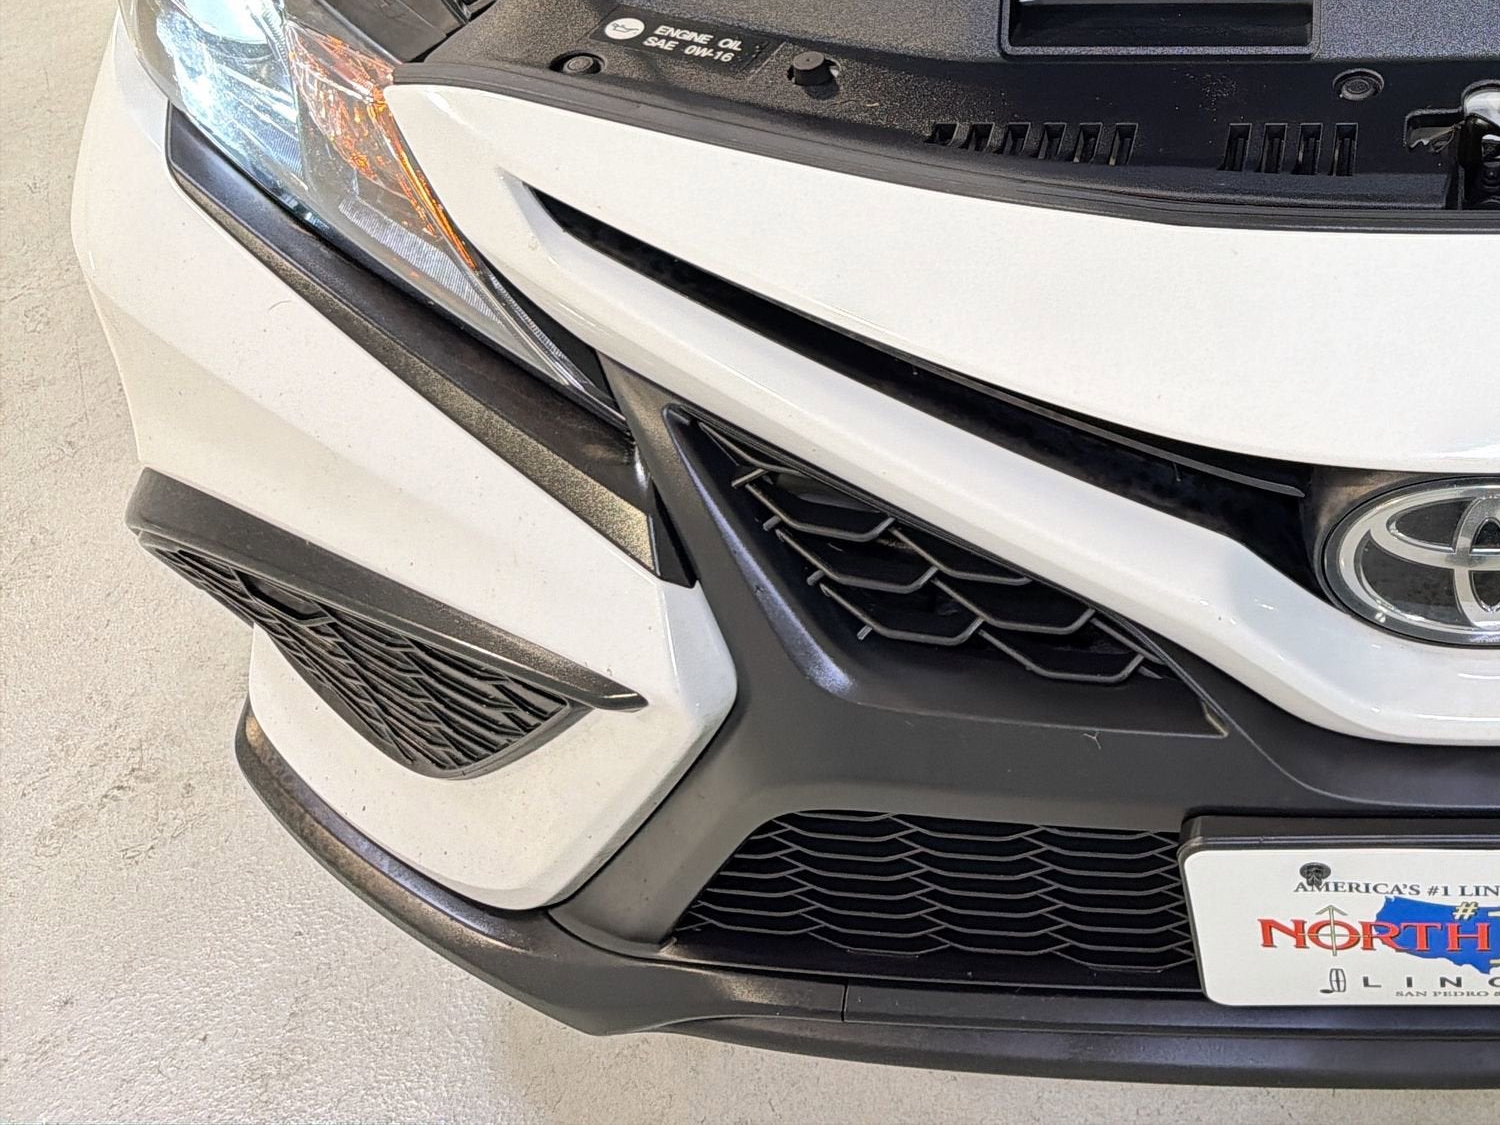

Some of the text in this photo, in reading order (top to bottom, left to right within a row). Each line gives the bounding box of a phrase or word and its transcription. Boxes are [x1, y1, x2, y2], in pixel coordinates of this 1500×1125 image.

[642, 36, 735, 63] SAE 0W-16
[653, 25, 743, 52] ENGINE OIL
[1293, 881, 1421, 896] AMERICA'S
[1427, 884, 1451, 897] #1
[1257, 918, 1493, 953] NORTH
[1394, 990, 1428, 998] SAN
[1432, 990, 1490, 998] PEDRO
